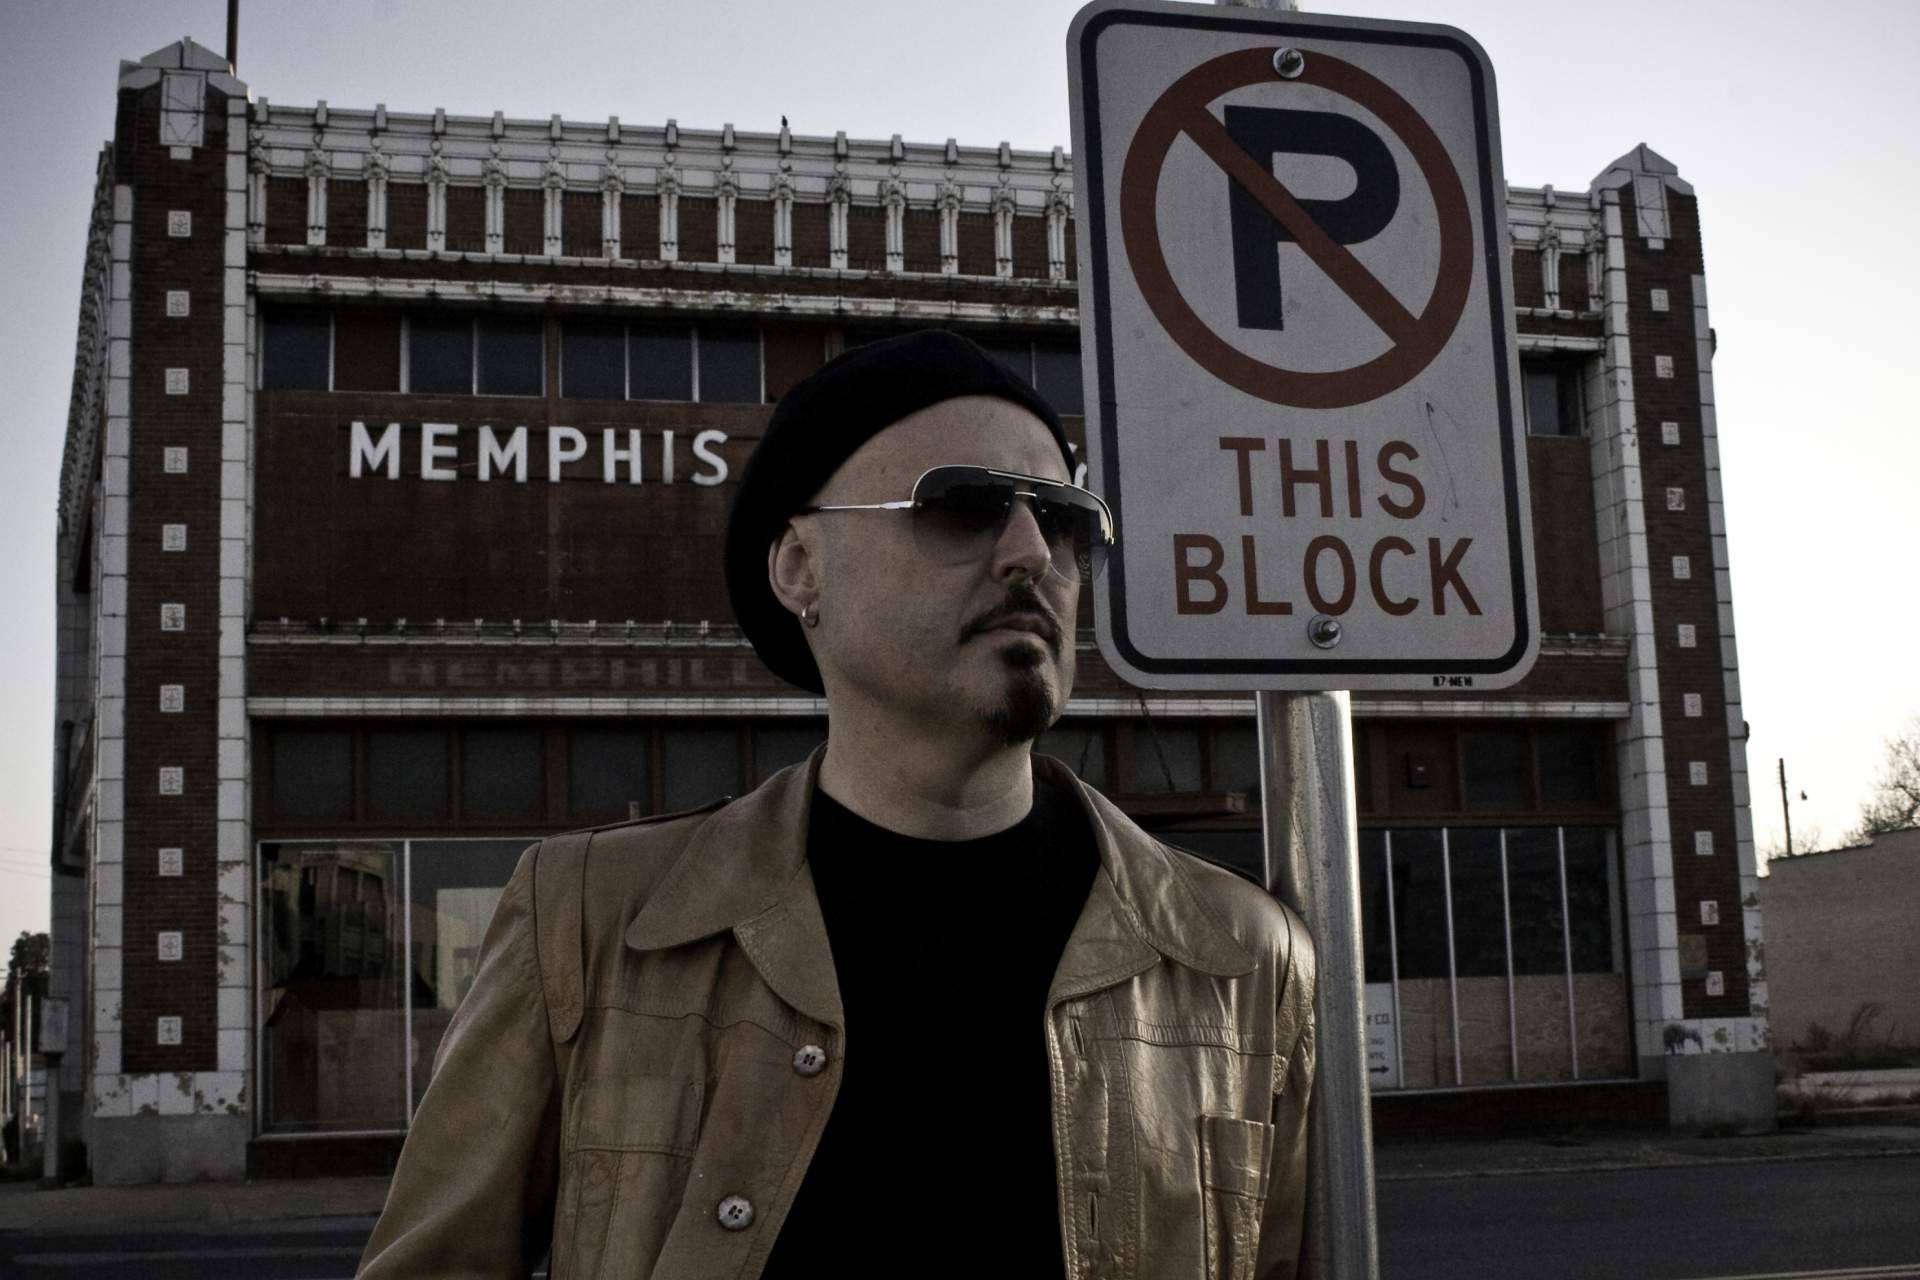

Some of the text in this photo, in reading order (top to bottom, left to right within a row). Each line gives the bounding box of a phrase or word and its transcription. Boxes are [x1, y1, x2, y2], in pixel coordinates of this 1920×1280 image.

[1223, 105, 1400, 331] P
[349, 421, 729, 486] MEMPHIS
[1219, 436, 1427, 520] THIS
[1173, 533, 1484, 617] BLOCK
